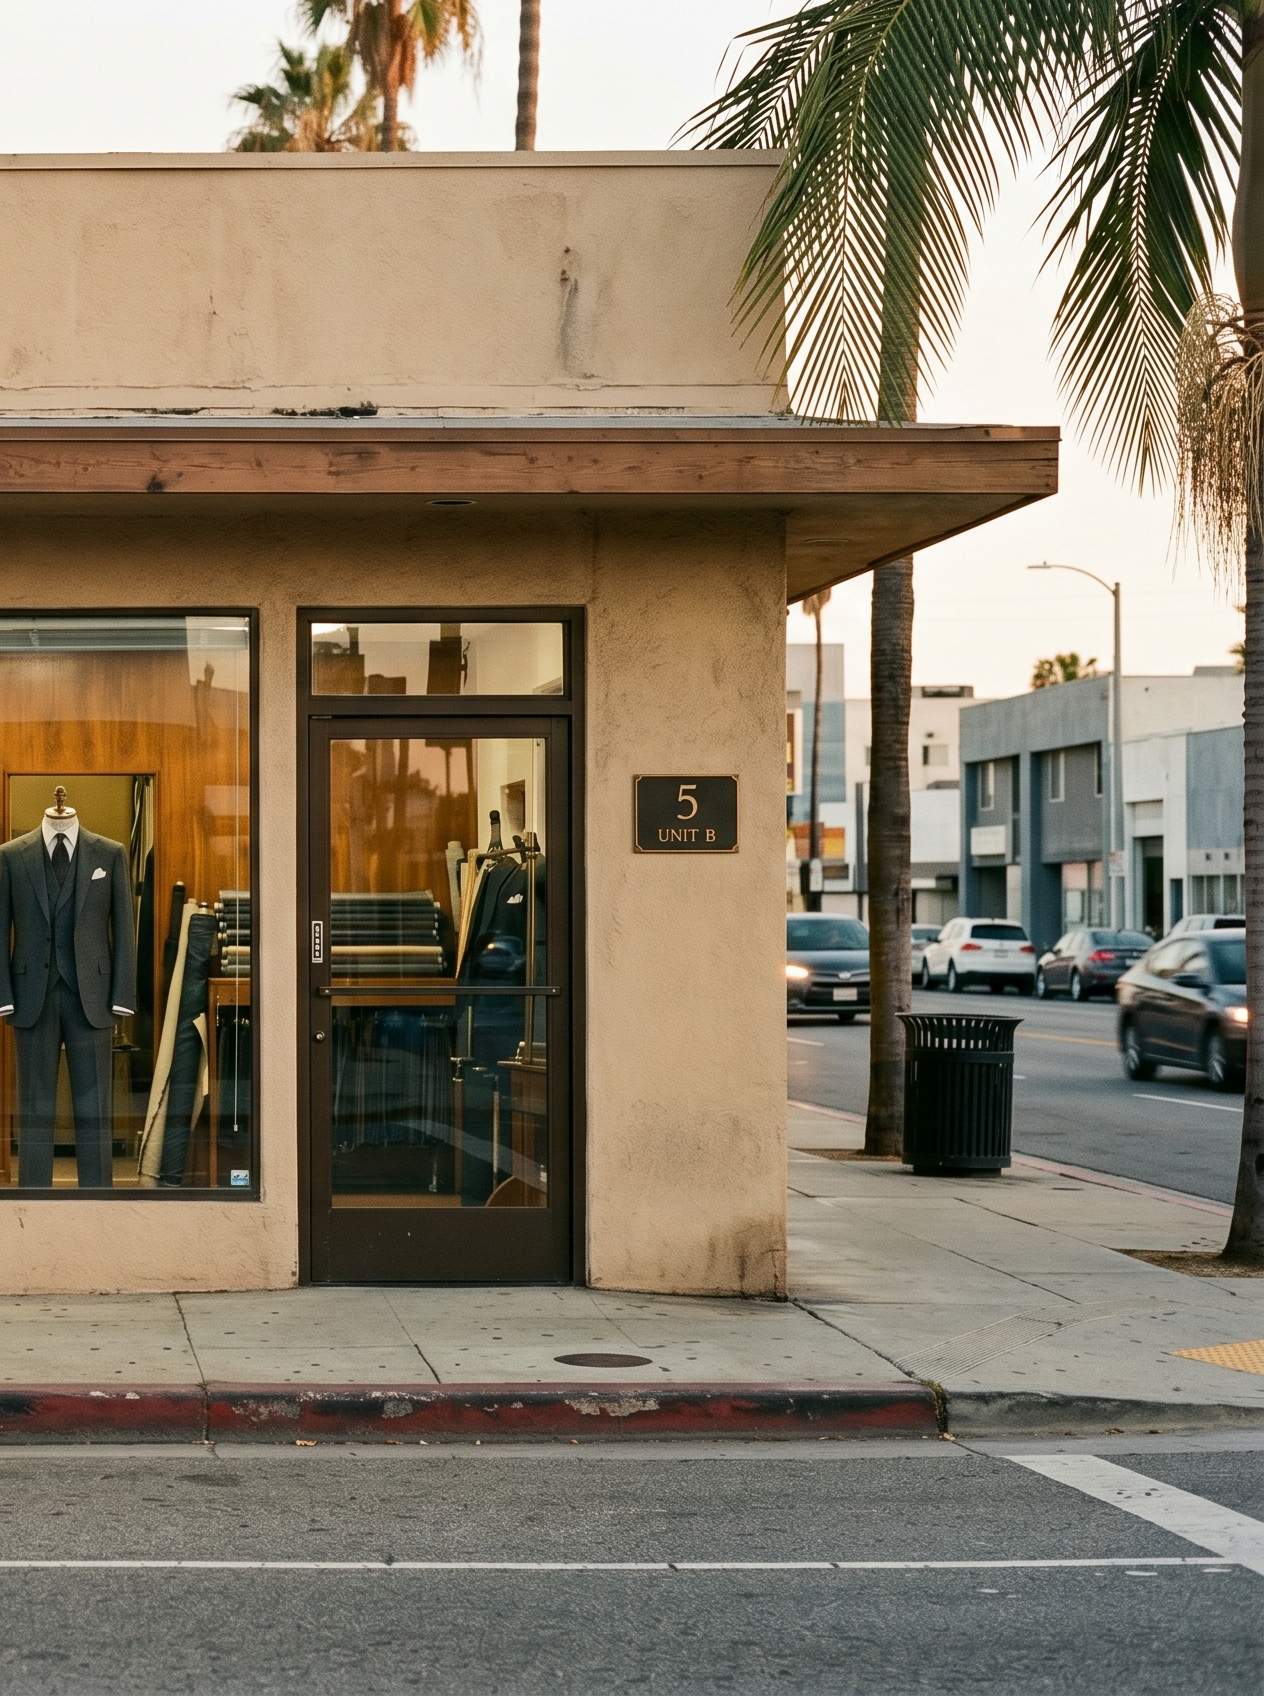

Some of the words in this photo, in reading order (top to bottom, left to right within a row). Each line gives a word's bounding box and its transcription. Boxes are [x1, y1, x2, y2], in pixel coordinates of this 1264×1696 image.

[677, 784, 698, 820] 5
[658, 829, 699, 842] UNIT
[705, 829, 716, 842] B
